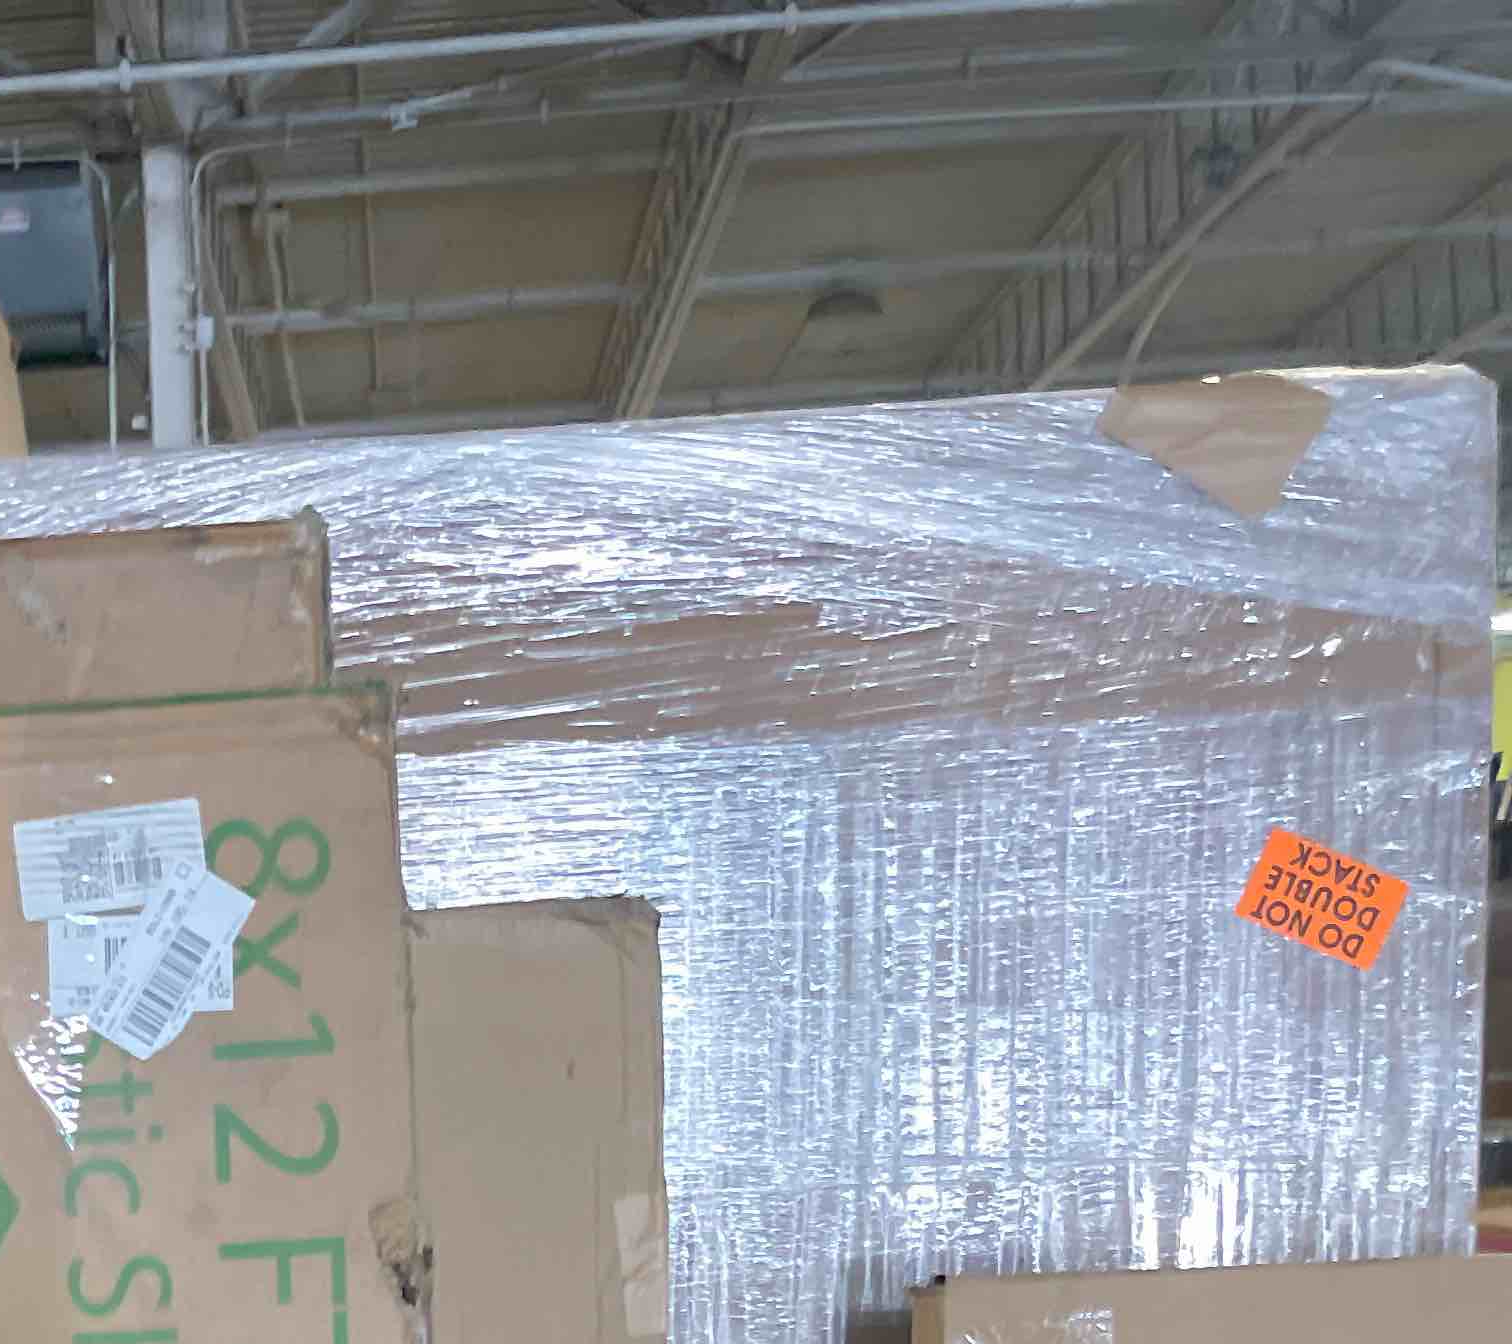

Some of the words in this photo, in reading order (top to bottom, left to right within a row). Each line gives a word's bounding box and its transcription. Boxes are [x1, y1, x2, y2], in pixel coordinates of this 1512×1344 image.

[1289, 842, 1380, 898] STACK
[1250, 895, 1312, 937] NOT
[1263, 865, 1380, 932] DOUBLE
[1318, 923, 1364, 959] DO
